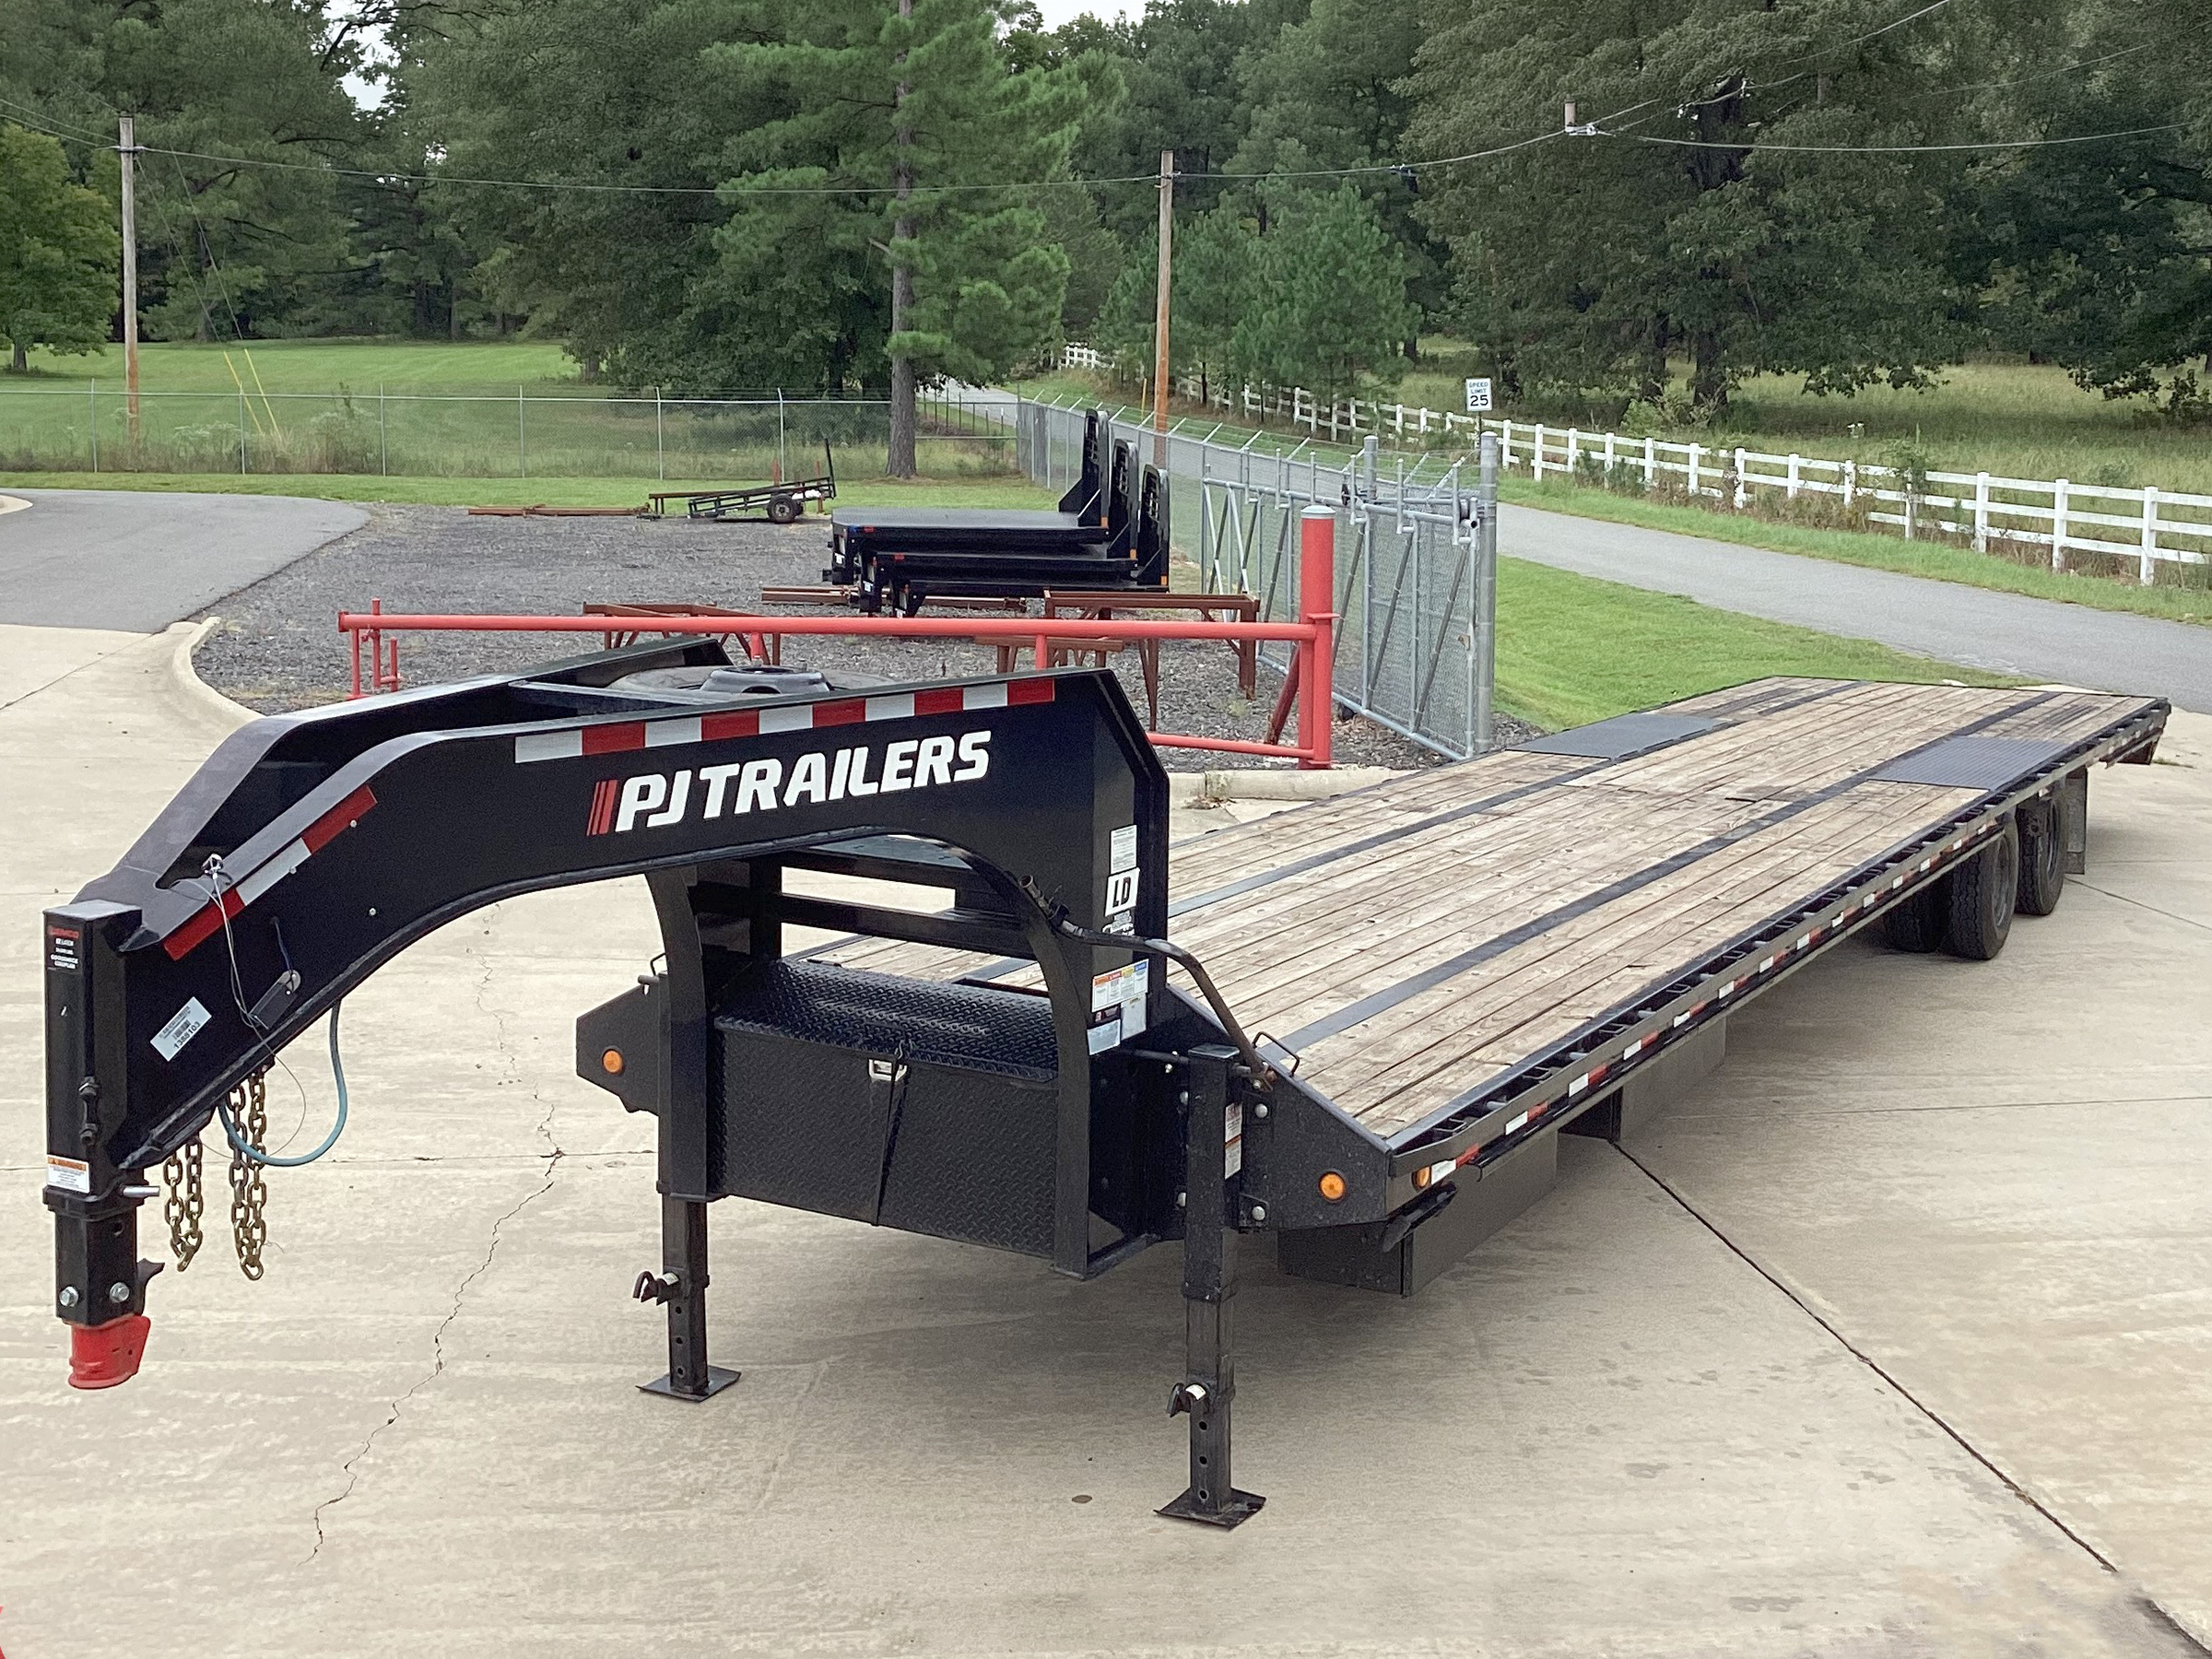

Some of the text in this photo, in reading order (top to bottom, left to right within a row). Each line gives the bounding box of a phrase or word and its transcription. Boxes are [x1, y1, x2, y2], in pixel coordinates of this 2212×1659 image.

[1470, 394, 1488, 406] 25
[615, 730, 992, 832] PJ TRAILERS
[1112, 877, 1131, 908] LD
